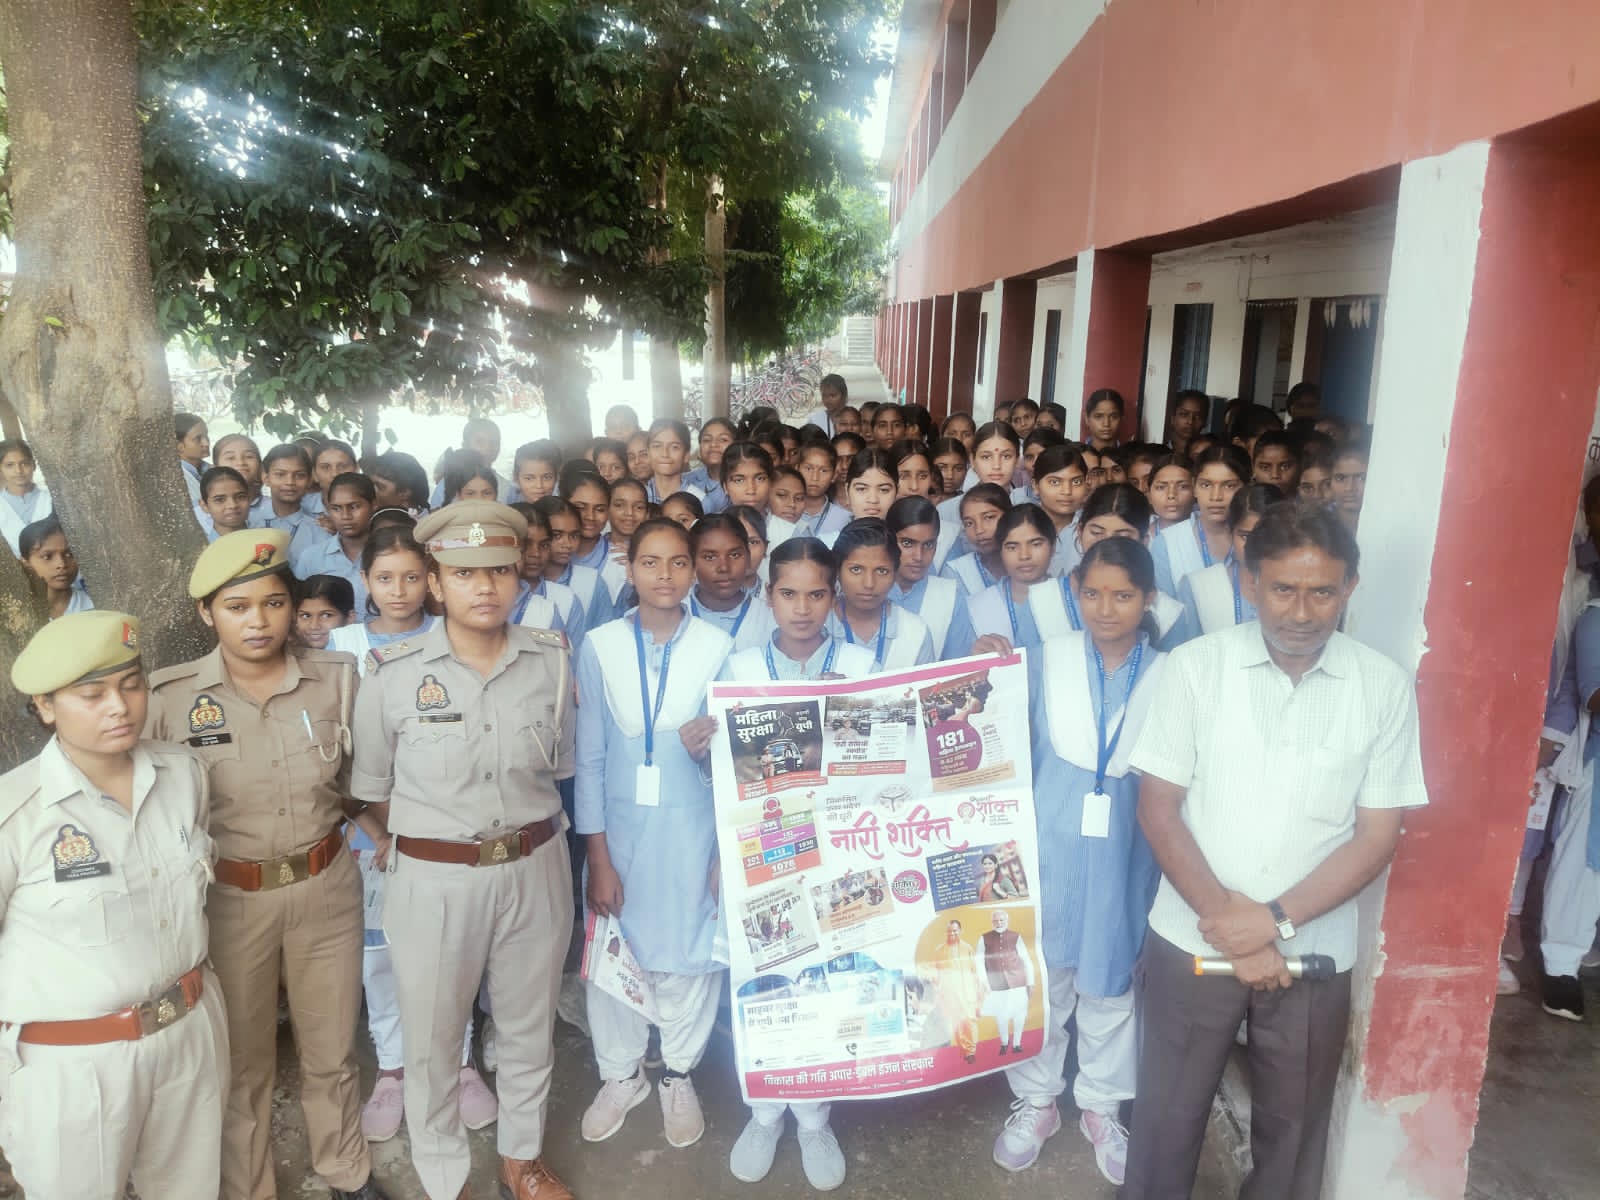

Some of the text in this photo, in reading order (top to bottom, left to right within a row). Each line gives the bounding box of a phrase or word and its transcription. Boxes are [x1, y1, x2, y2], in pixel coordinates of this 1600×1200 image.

[735, 709, 777, 725] महिला
[736, 723, 774, 743] सुरक्षा
[795, 720, 813, 733] यूपी
[936, 728, 965, 750] 181
[828, 810, 884, 860] नारी
[885, 804, 969, 858] शक्ति
[797, 1071, 808, 1085] की
